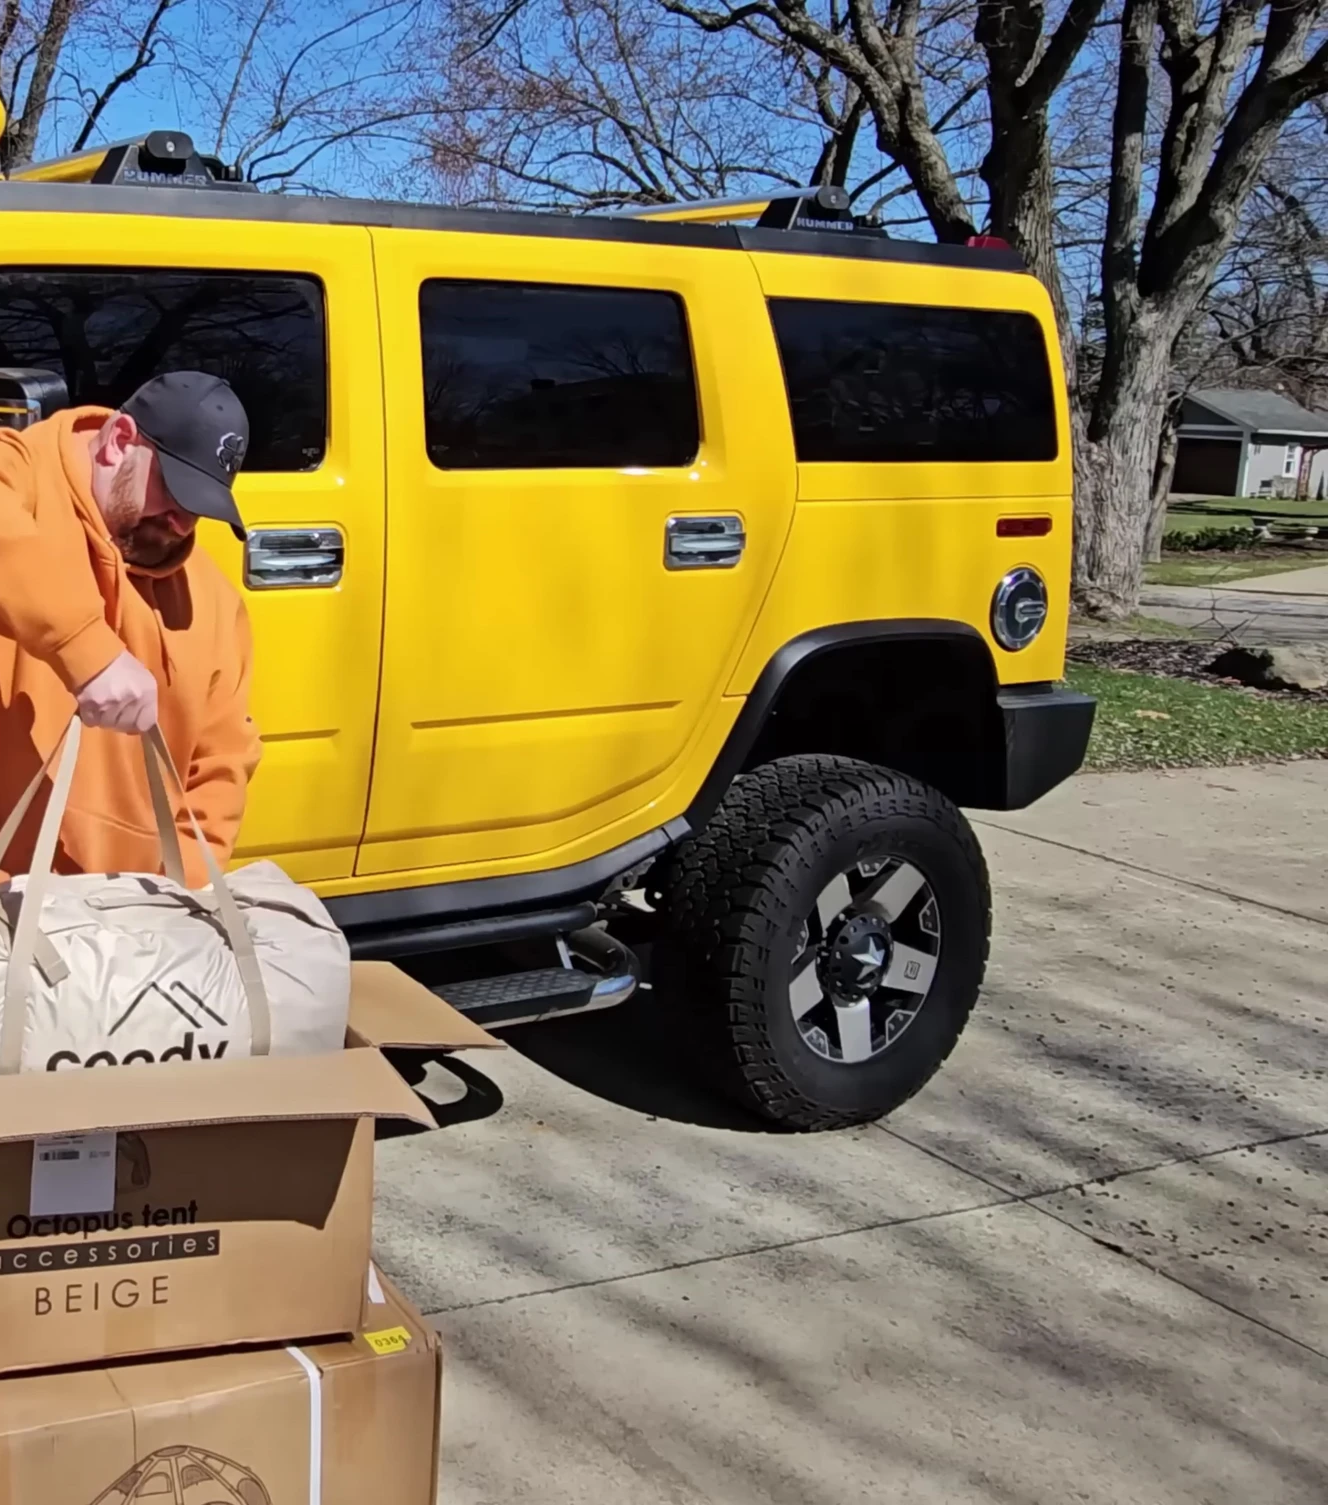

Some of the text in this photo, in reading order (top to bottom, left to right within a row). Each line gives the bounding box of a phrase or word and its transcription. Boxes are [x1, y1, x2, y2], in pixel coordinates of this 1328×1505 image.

[796, 217, 854, 231] HUMMER
[6, 1199, 198, 1240] Octopus tent
[34, 1275, 169, 1316] BEIGE
